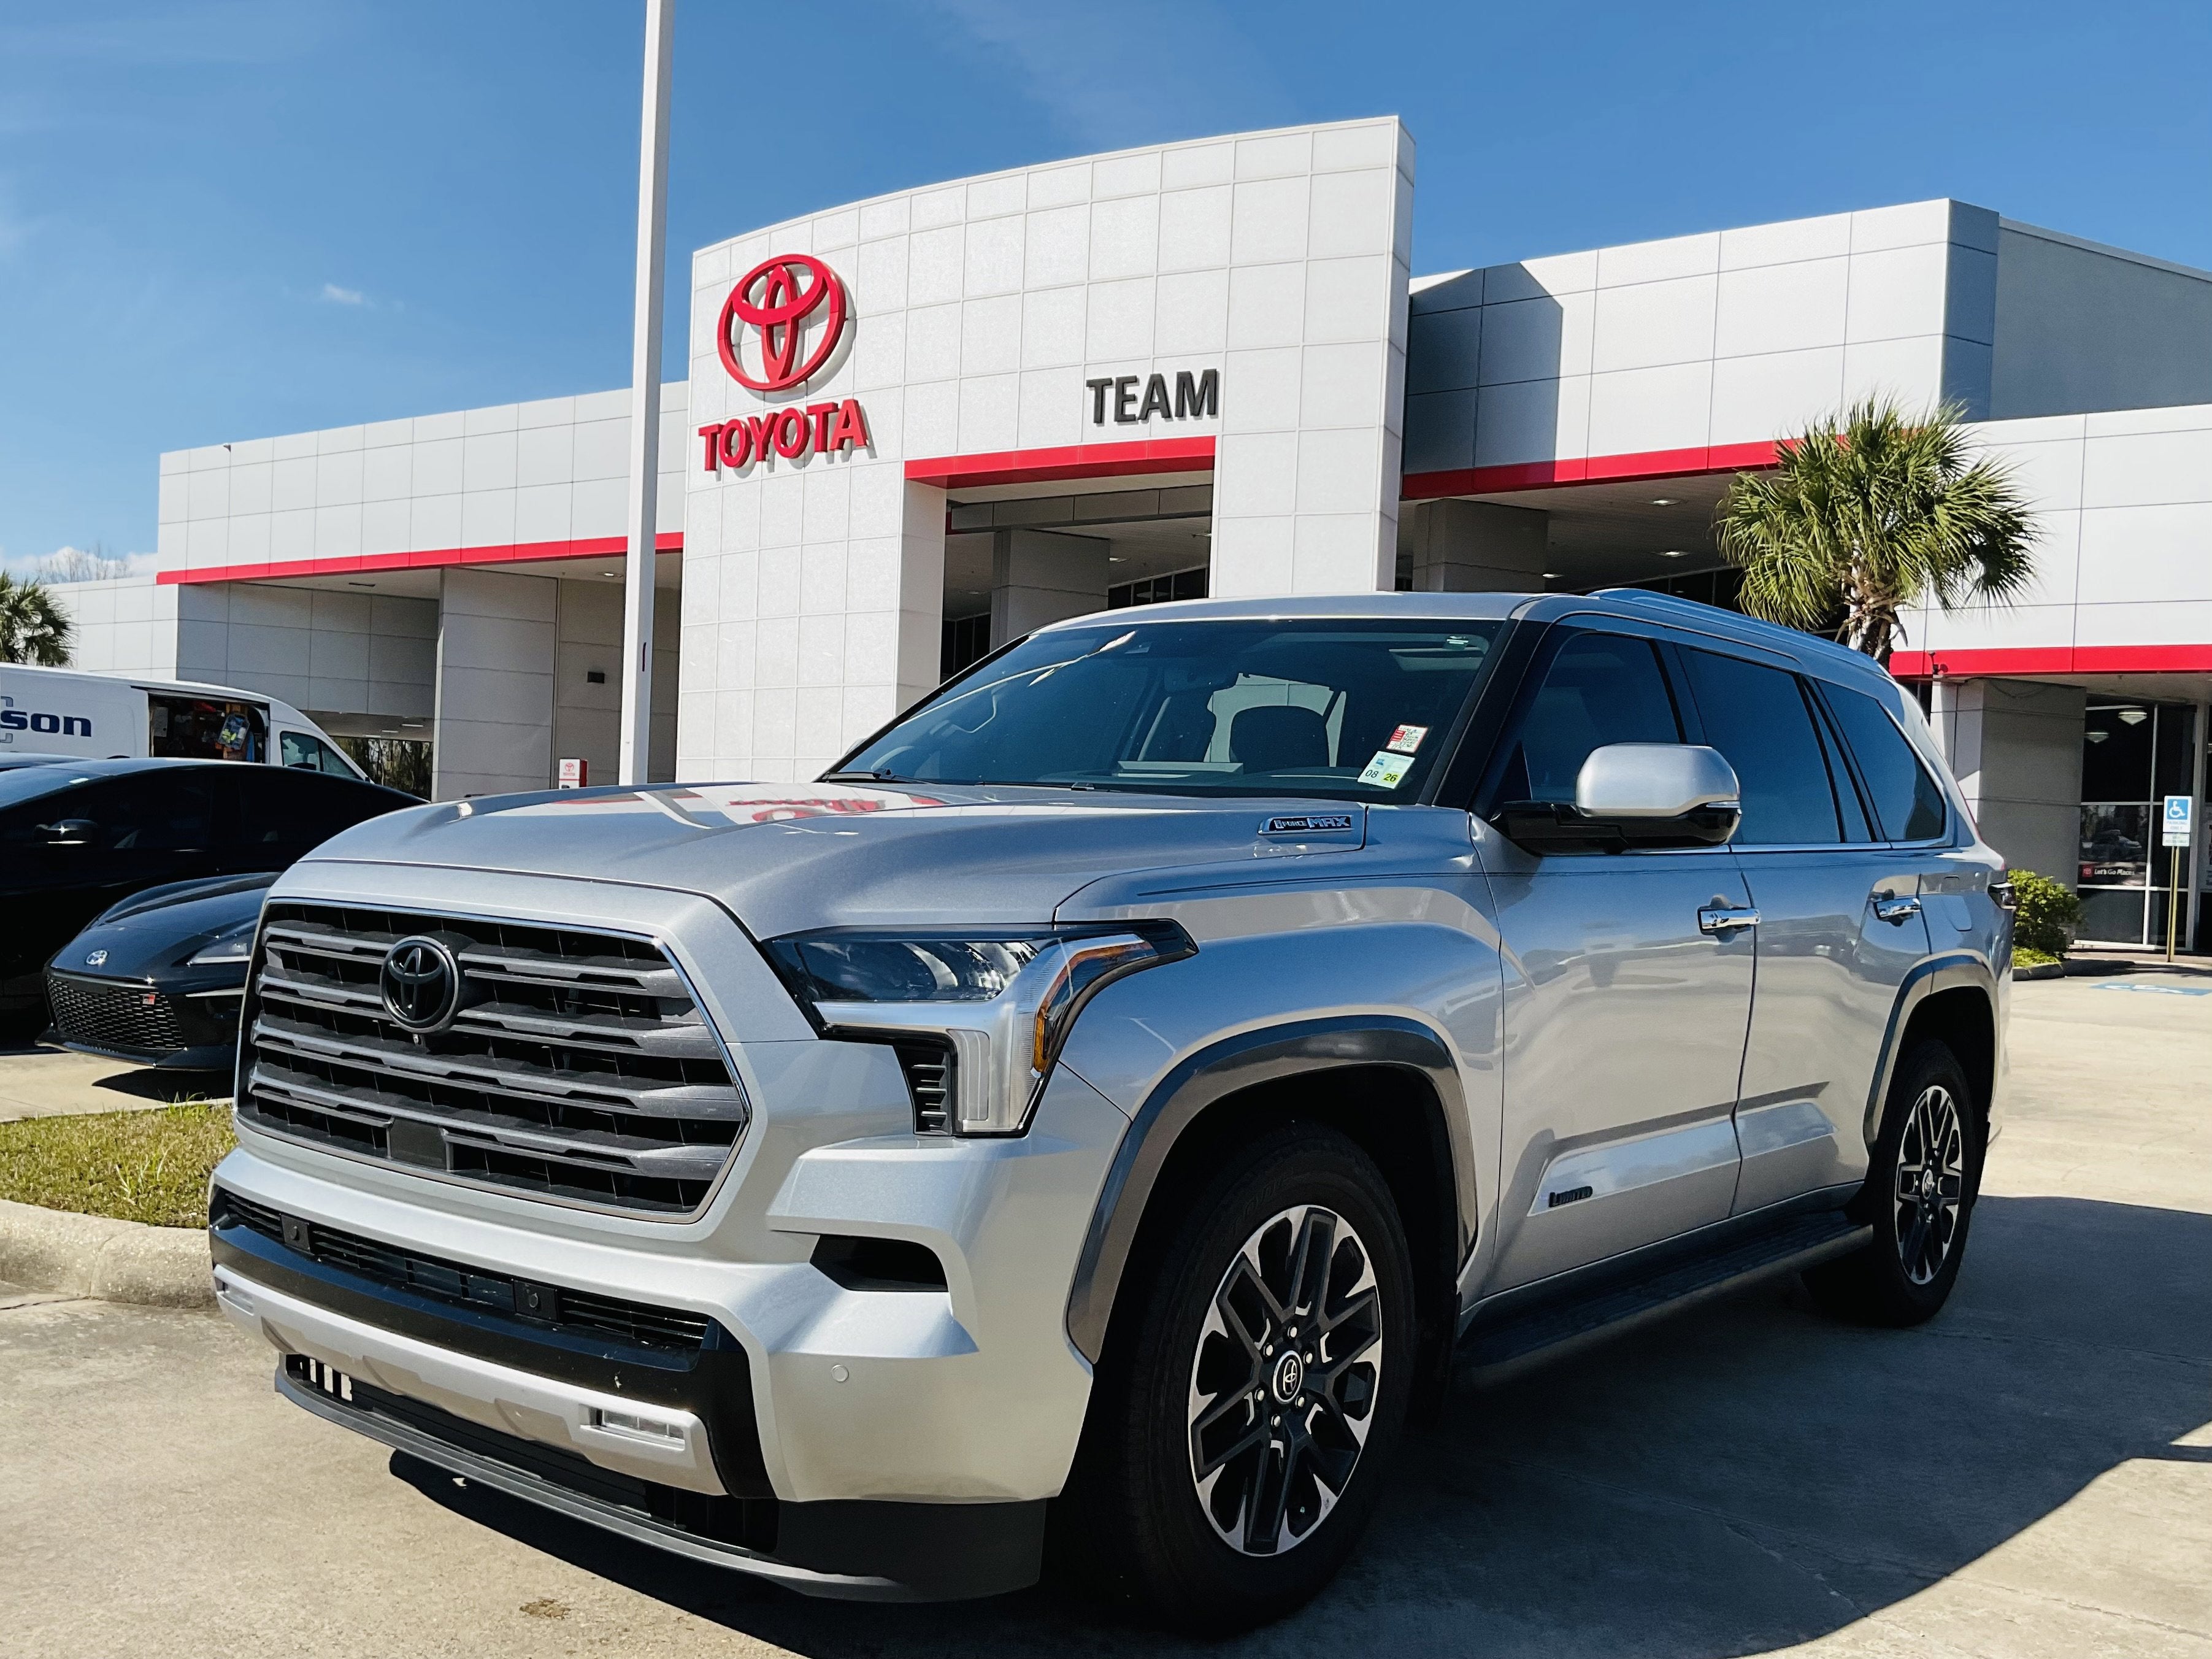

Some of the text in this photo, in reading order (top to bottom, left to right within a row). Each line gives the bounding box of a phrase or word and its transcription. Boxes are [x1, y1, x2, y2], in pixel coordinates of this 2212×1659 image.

[1086, 369, 1217, 423] TEAM
[699, 399, 869, 471] TOYOTA
[1365, 769, 1398, 782] 08 26
[1307, 817, 1350, 828] MAX
